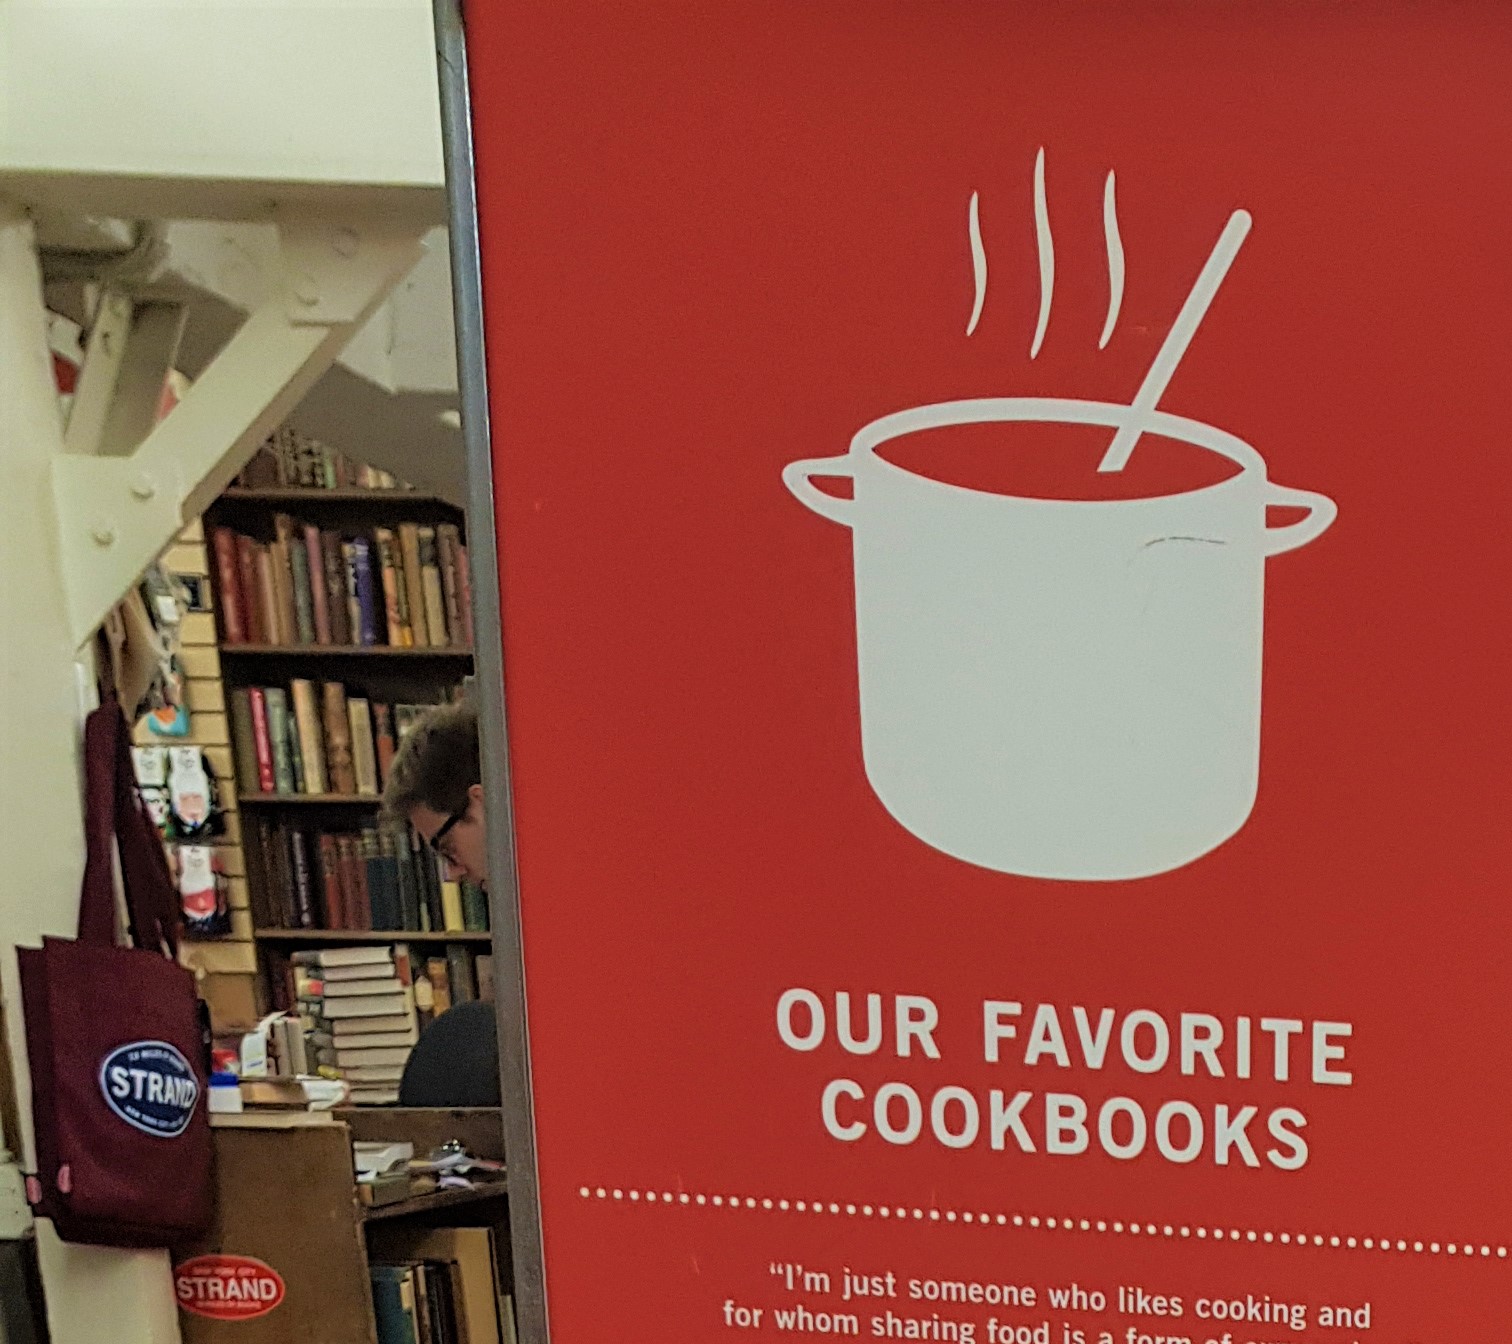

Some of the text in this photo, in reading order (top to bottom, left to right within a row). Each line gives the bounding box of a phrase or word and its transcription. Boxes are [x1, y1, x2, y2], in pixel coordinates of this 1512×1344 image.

[776, 988, 1353, 1085] OUR FAVORITE
[111, 1066, 197, 1109] STRAND
[821, 1079, 1309, 1170] COOKBOOKS
[177, 1278, 277, 1299] STRAND
[842, 1267, 897, 1301] just
[908, 1279, 1037, 1307] someone
[1048, 1283, 1106, 1312] who
[1118, 1286, 1183, 1317] likes
[1195, 1294, 1307, 1331] cooking
[1318, 1302, 1371, 1329] and
[722, 1299, 763, 1328] for
[774, 1304, 859, 1335] whom
